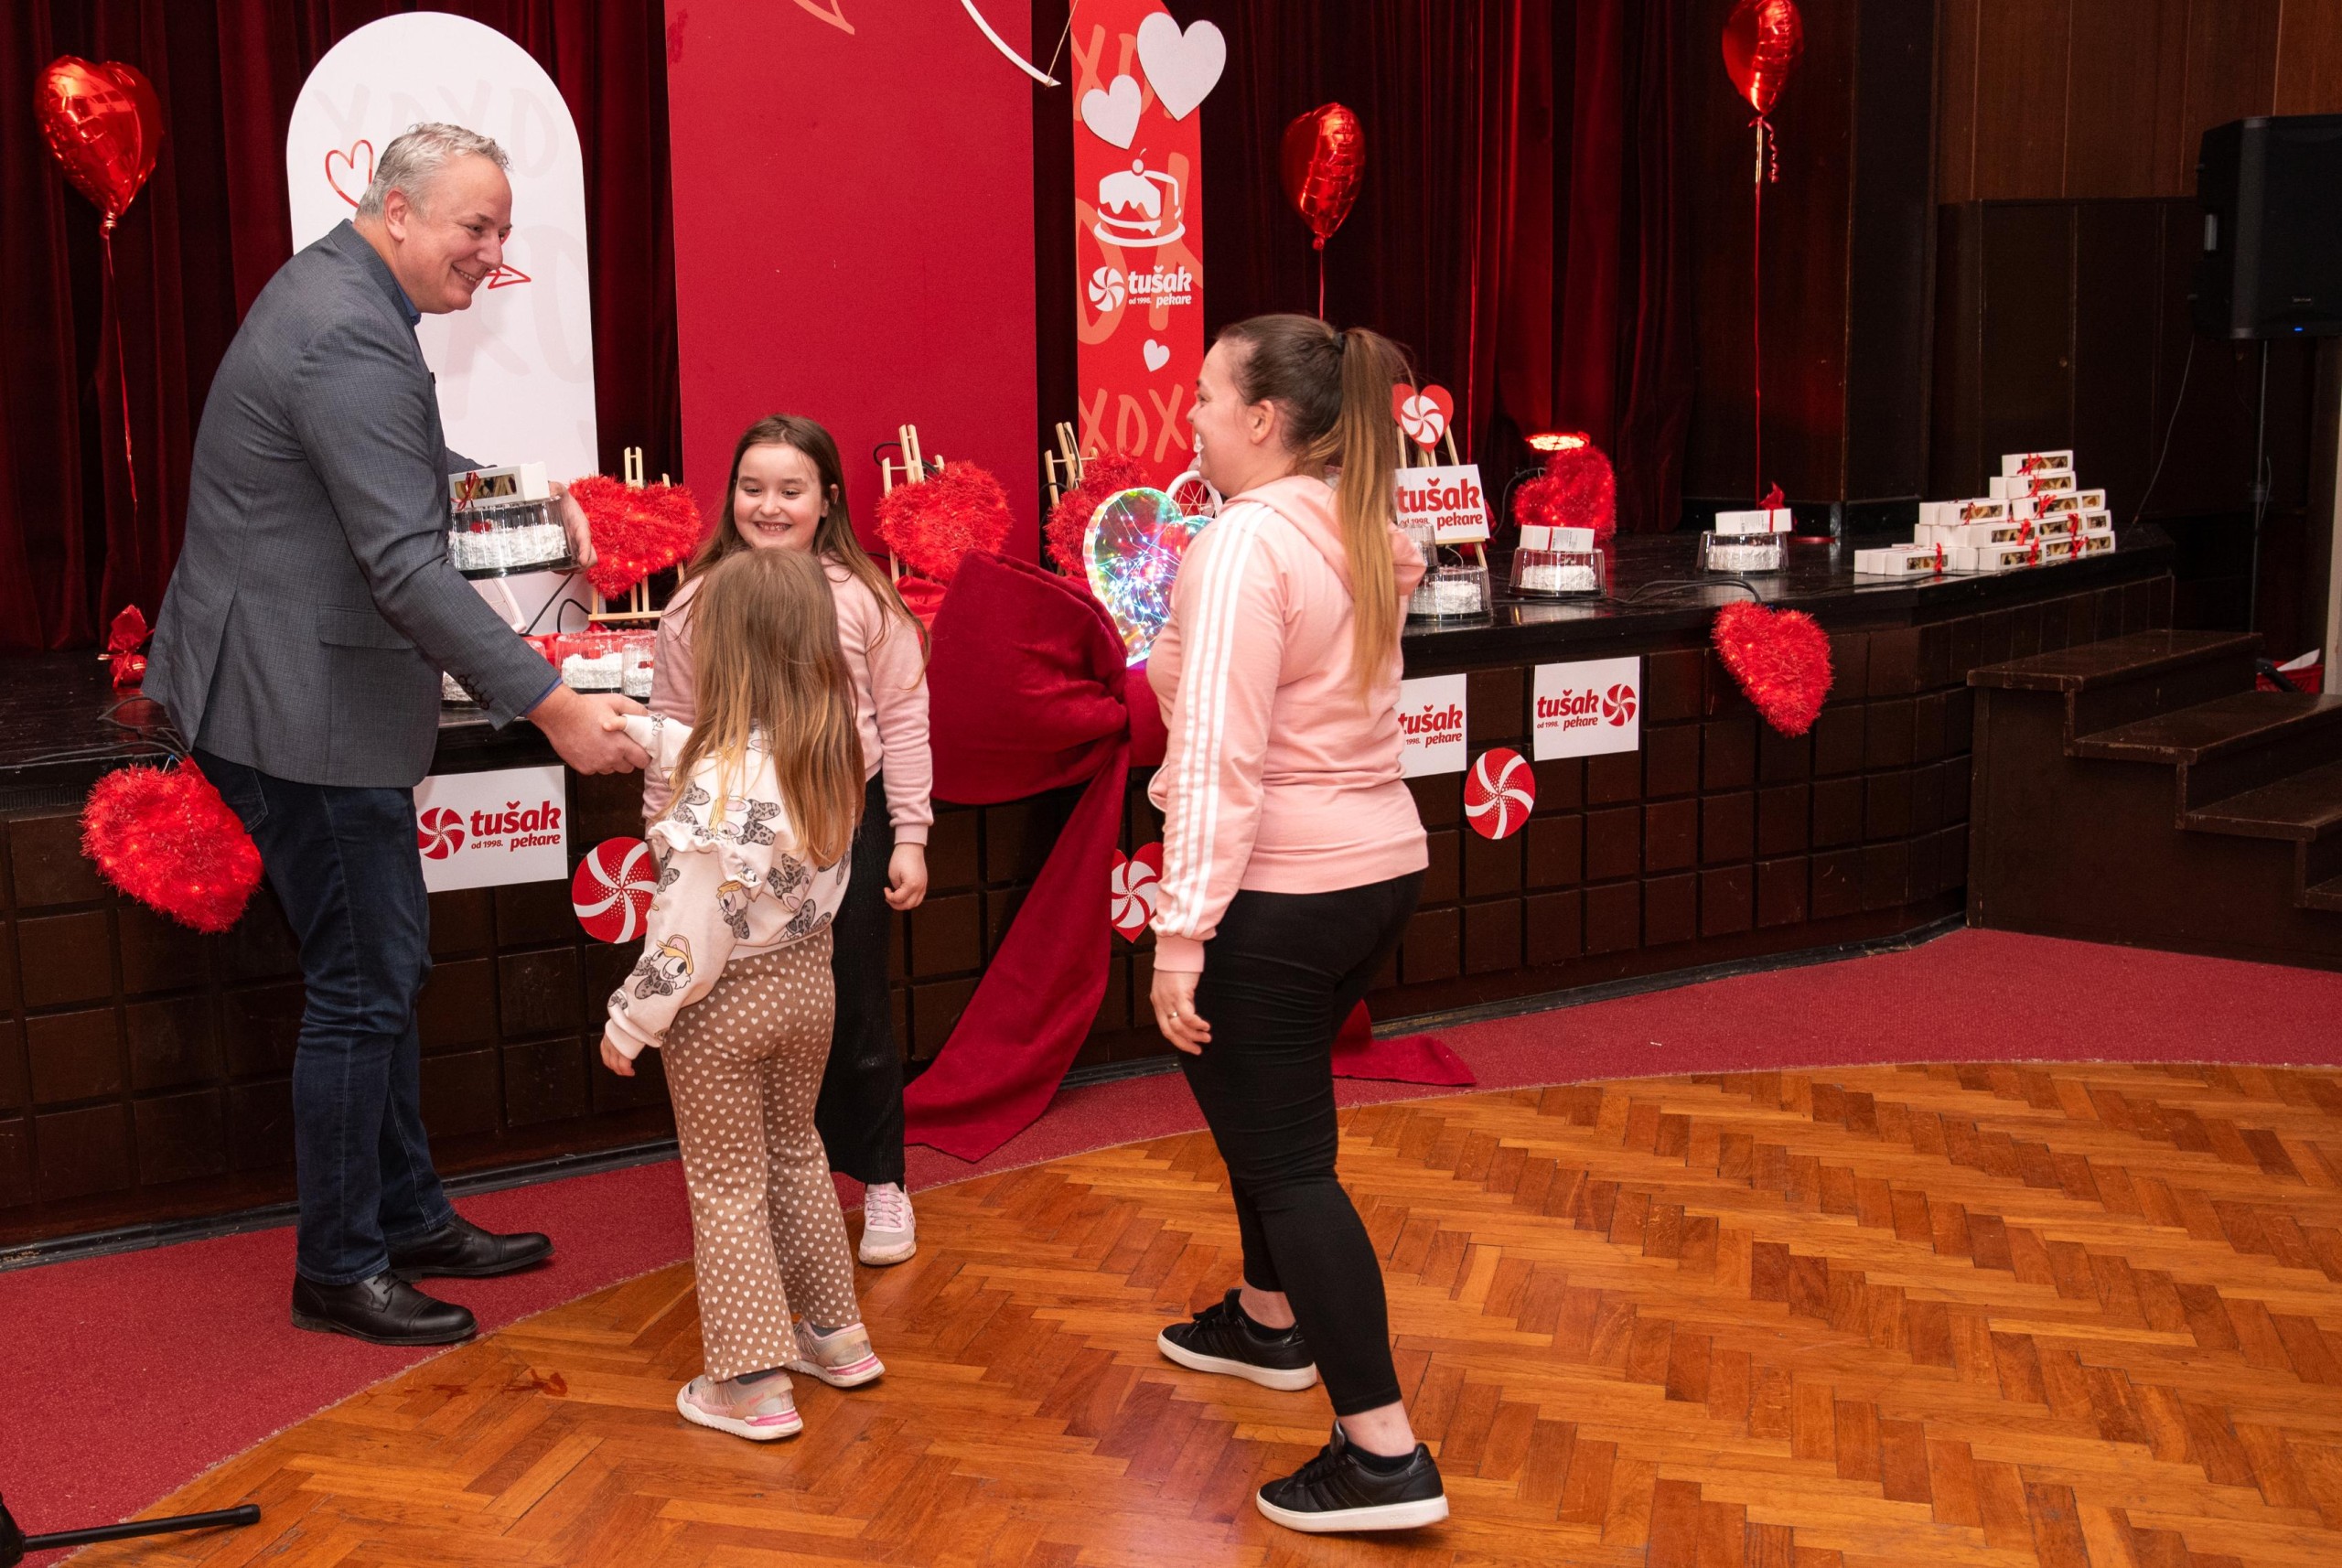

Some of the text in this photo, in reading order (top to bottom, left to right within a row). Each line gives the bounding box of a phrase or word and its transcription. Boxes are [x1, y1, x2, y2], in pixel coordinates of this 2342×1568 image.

[1128, 265, 1192, 295] tušak
[1155, 294, 1191, 309] pekare
[1396, 478, 1480, 514] tušak
[1437, 512, 1482, 531] pekare
[1537, 689, 1599, 718] tušak
[1563, 716, 1598, 731] pekare
[1425, 732, 1463, 748] pekare
[470, 800, 561, 837] tušak
[471, 833, 561, 852] od 1998. pekare
